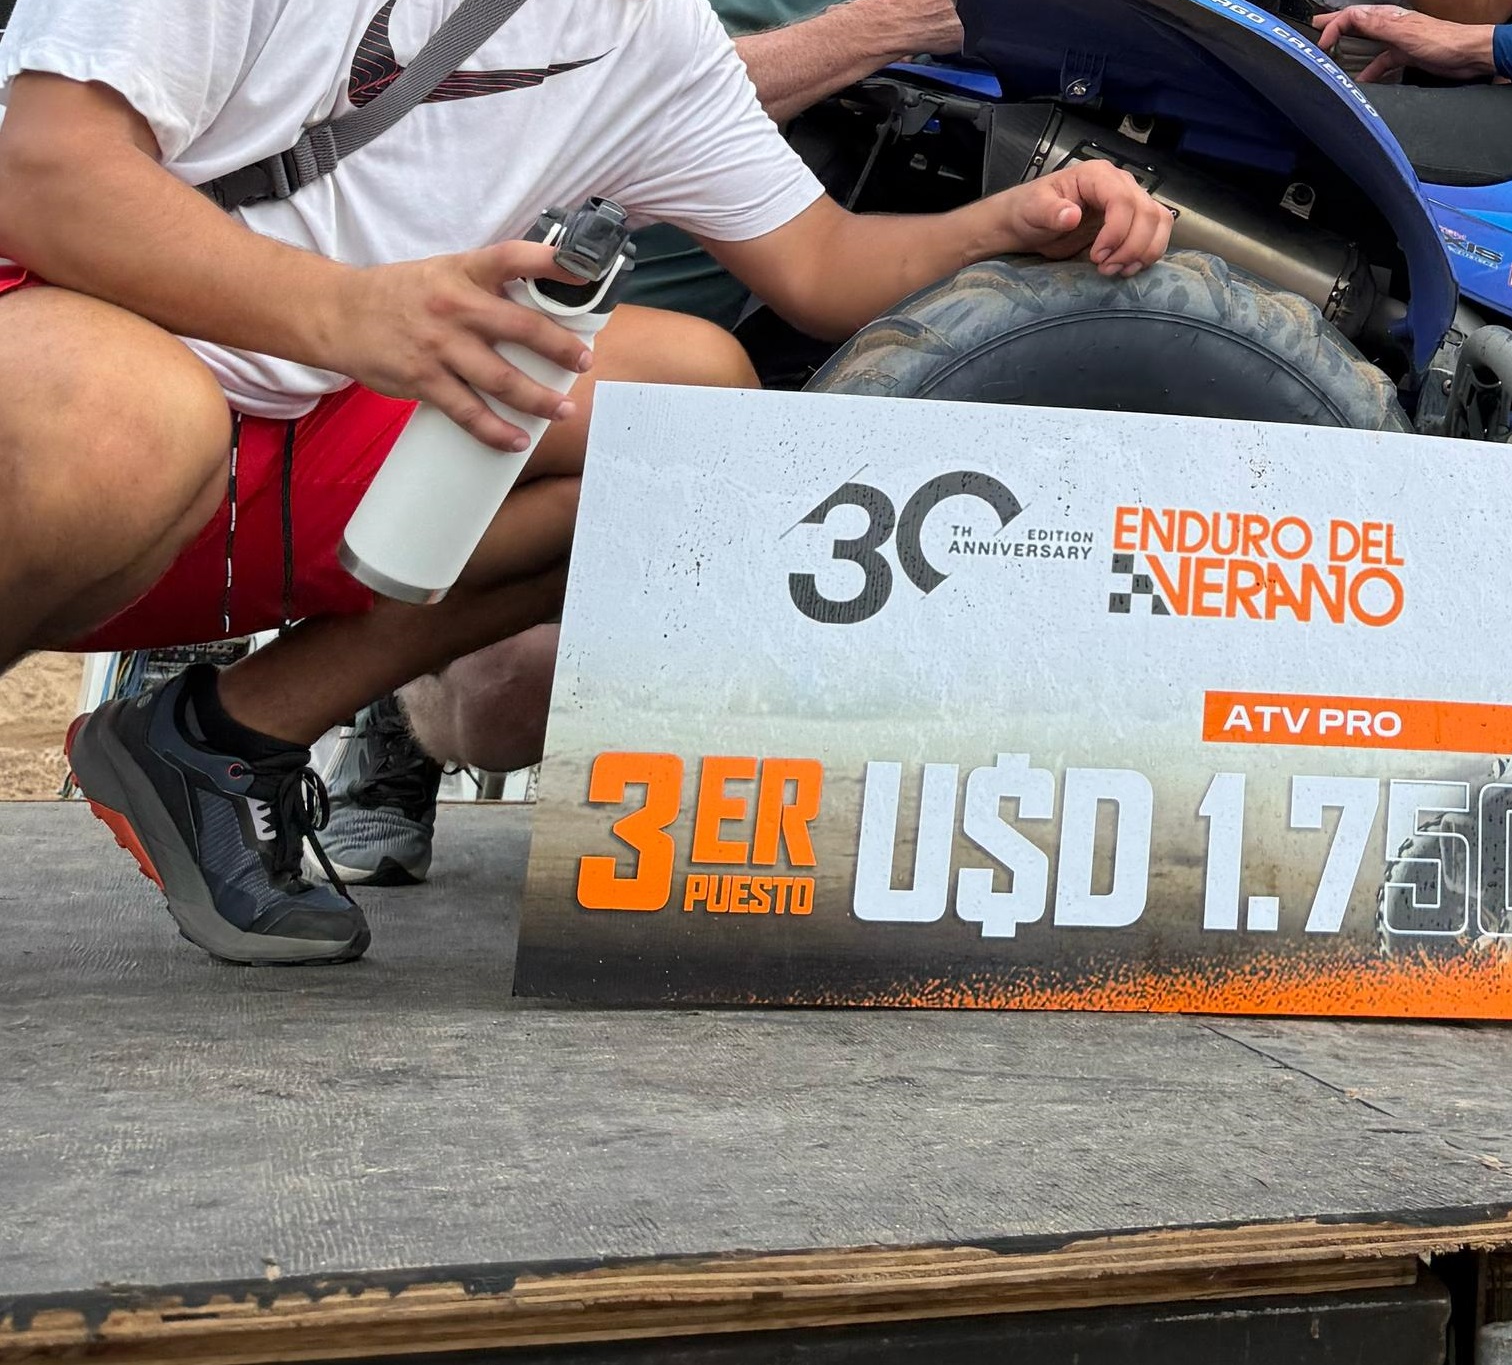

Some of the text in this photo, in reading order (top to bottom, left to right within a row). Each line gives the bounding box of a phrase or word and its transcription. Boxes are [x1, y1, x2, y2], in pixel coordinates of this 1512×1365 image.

[1272, 26, 1380, 118] CALIENDO
[788, 470, 1023, 625] 30
[948, 540, 1093, 560] ANNIVERSARY
[952, 525, 972, 537] TH
[1027, 529, 1094, 543] EDITION
[1112, 506, 1405, 567] ENDURO DEL
[1142, 553, 1403, 628] VERANO
[1222, 703, 1403, 739] ATV PRO
[852, 752, 1155, 940] U$D
[683, 873, 815, 916] PUESTO
